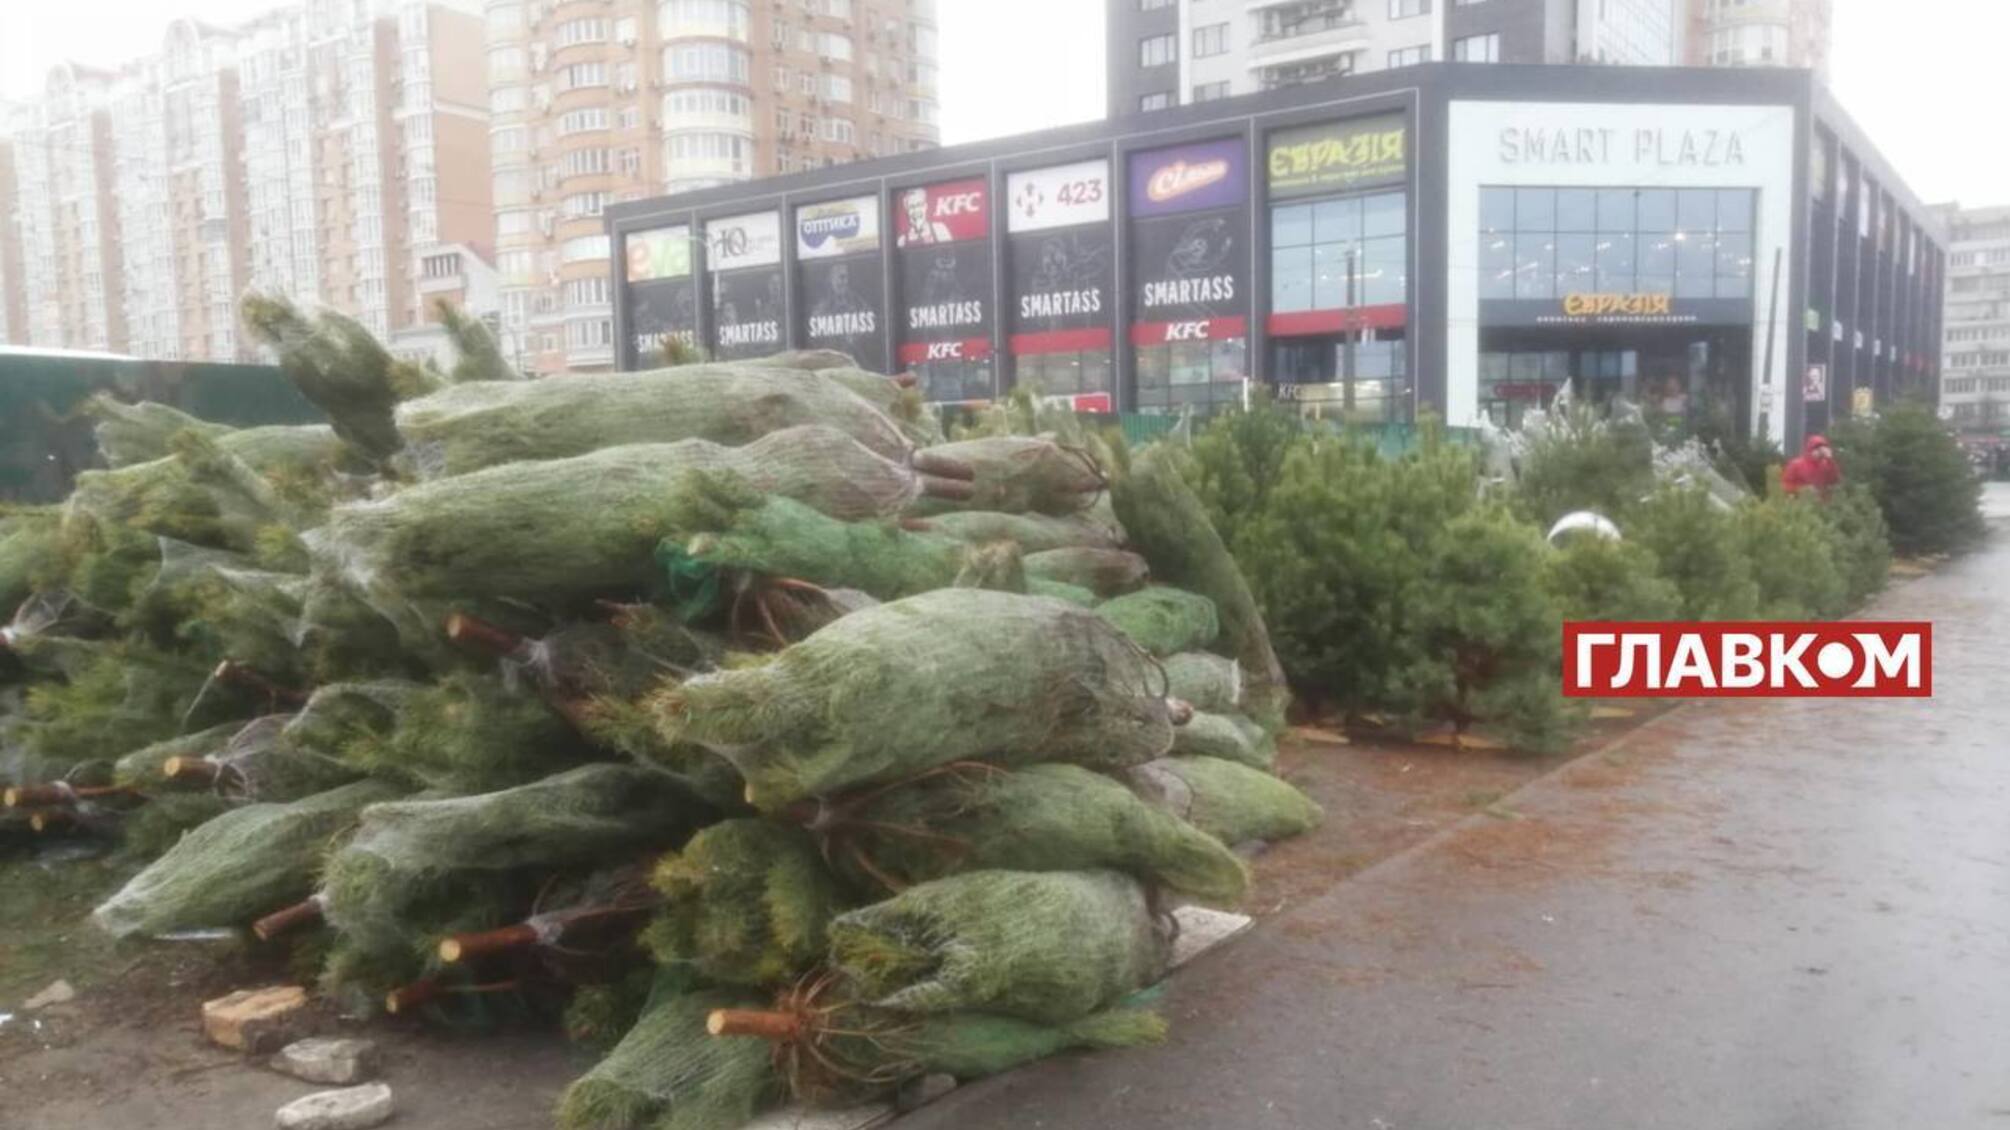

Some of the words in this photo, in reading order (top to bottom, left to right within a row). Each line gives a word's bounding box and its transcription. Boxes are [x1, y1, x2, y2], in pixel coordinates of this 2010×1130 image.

[1499, 127, 1614, 164] SMART
[1635, 127, 1744, 166] PLAZA
[934, 192, 981, 217] KFC
[1057, 179, 1102, 206] 423
[1021, 289, 1101, 319] SMARTASS
[1144, 275, 1234, 307] SMARTASS
[809, 311, 876, 338] SMARTASS
[909, 300, 982, 329] SMARTASS
[719, 321, 778, 346] SMARTASS
[1165, 321, 1210, 341] KFC
[927, 343, 963, 360] KFC
